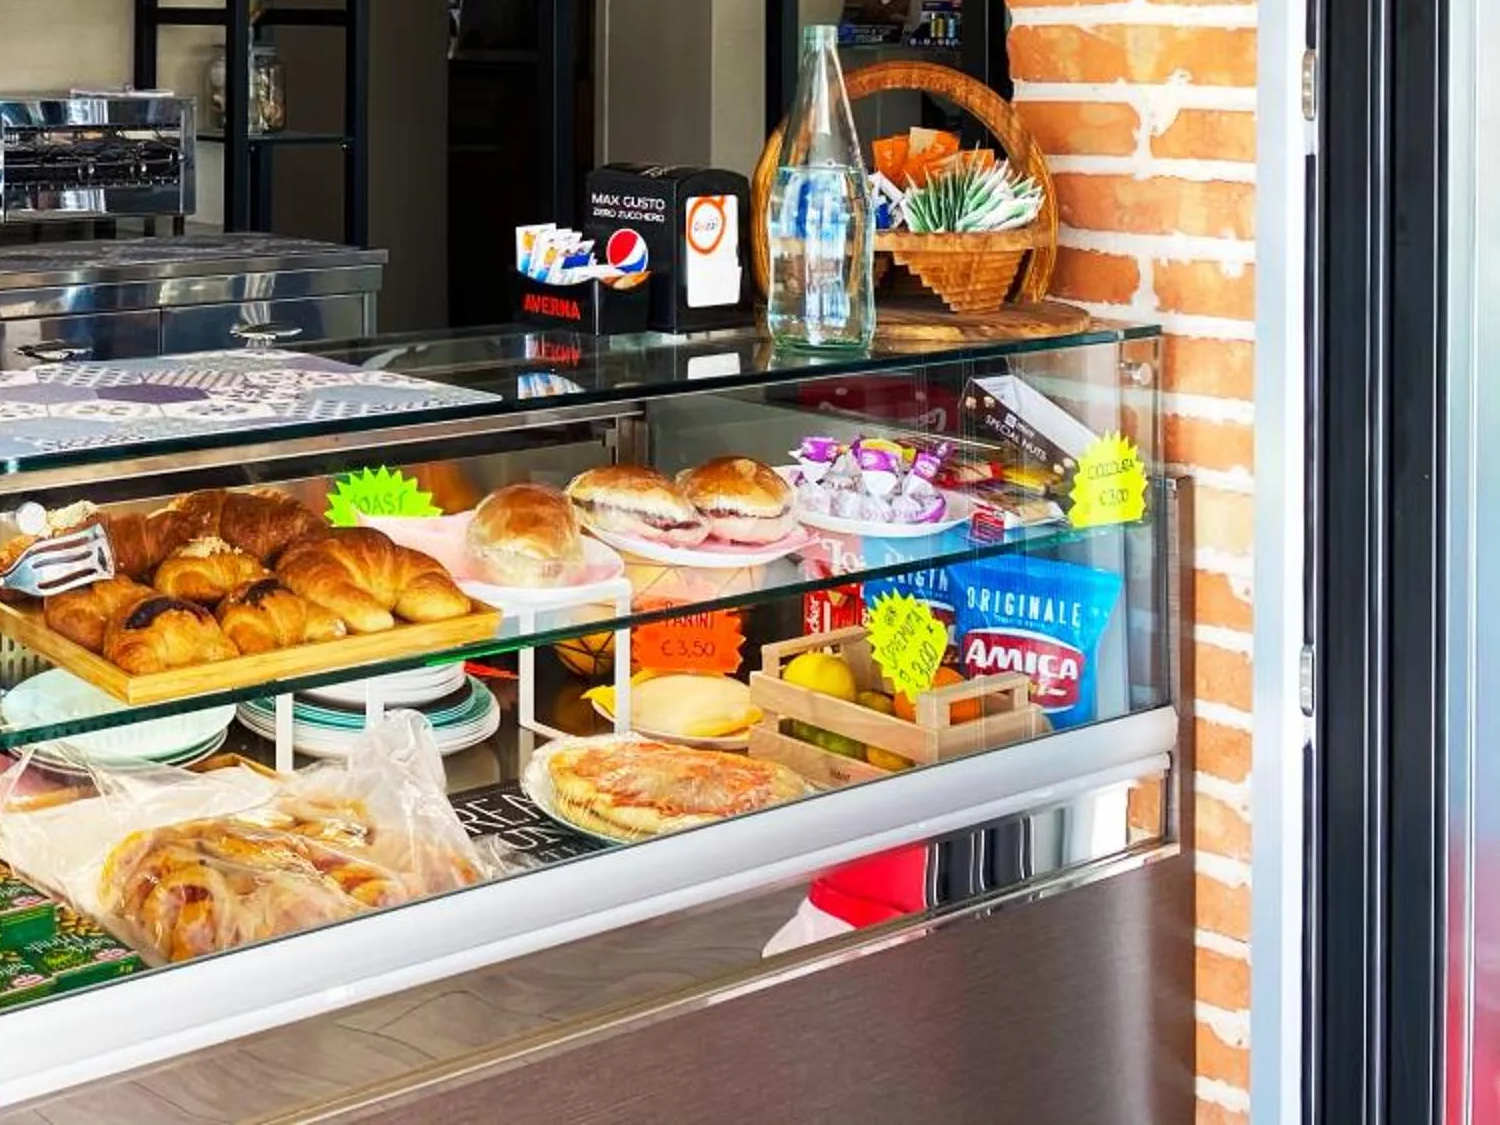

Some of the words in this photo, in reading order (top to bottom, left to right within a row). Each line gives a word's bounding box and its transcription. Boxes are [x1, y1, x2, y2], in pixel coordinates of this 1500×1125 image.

[591, 193, 620, 206] MAX
[593, 208, 616, 218] ZERO
[618, 209, 665, 222] ZUCCHERO
[523, 293, 581, 320] AVERNA
[966, 586, 1082, 628] ORIGINALE
[965, 638, 1078, 681] AMICA
